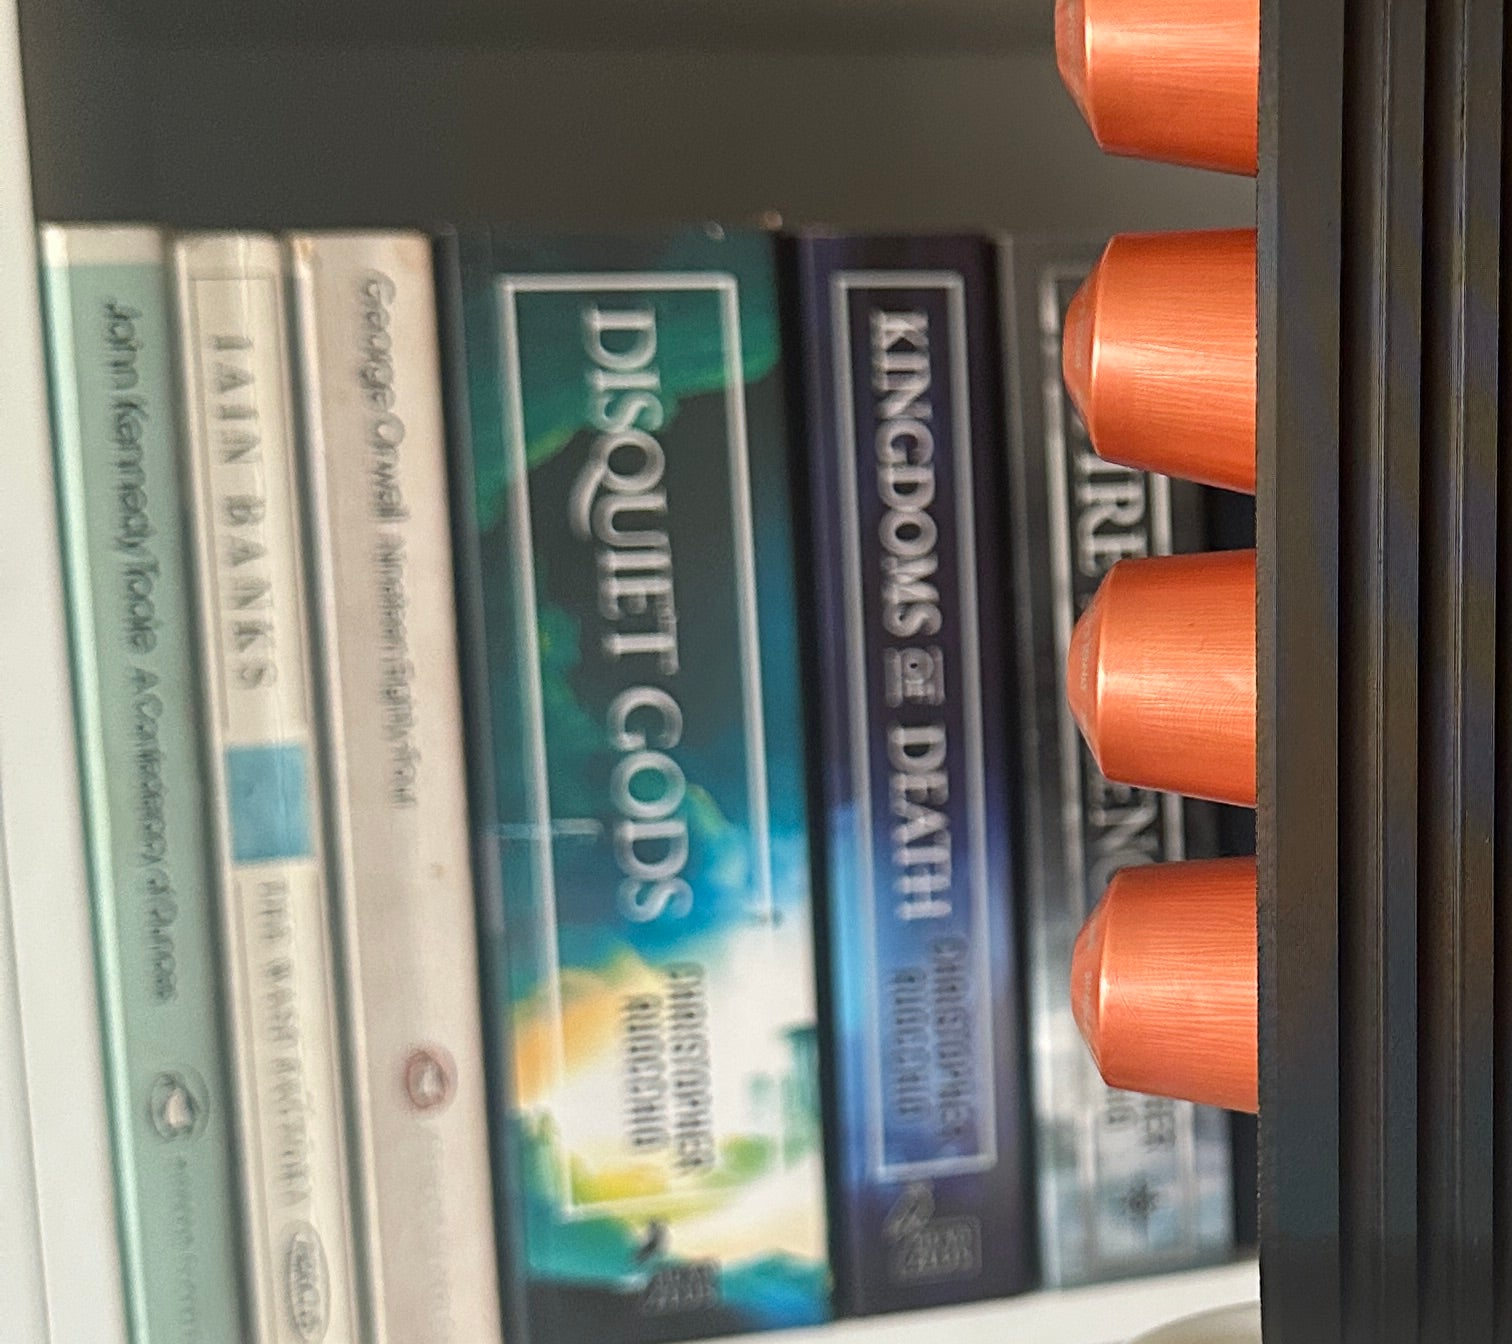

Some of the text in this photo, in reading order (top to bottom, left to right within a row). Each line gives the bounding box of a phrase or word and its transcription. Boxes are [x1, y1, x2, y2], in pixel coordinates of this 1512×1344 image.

[101, 298, 144, 392] John
[354, 272, 399, 409] George
[106, 394, 158, 555] Kennedy
[207, 332, 279, 691] IAIN BANKS
[368, 412, 413, 523] Orwell
[867, 307, 945, 638] KINGDOMS
[121, 556, 161, 656] Toole
[568, 303, 694, 923] DISQUIET GODS
[886, 718, 954, 924] DEATH
